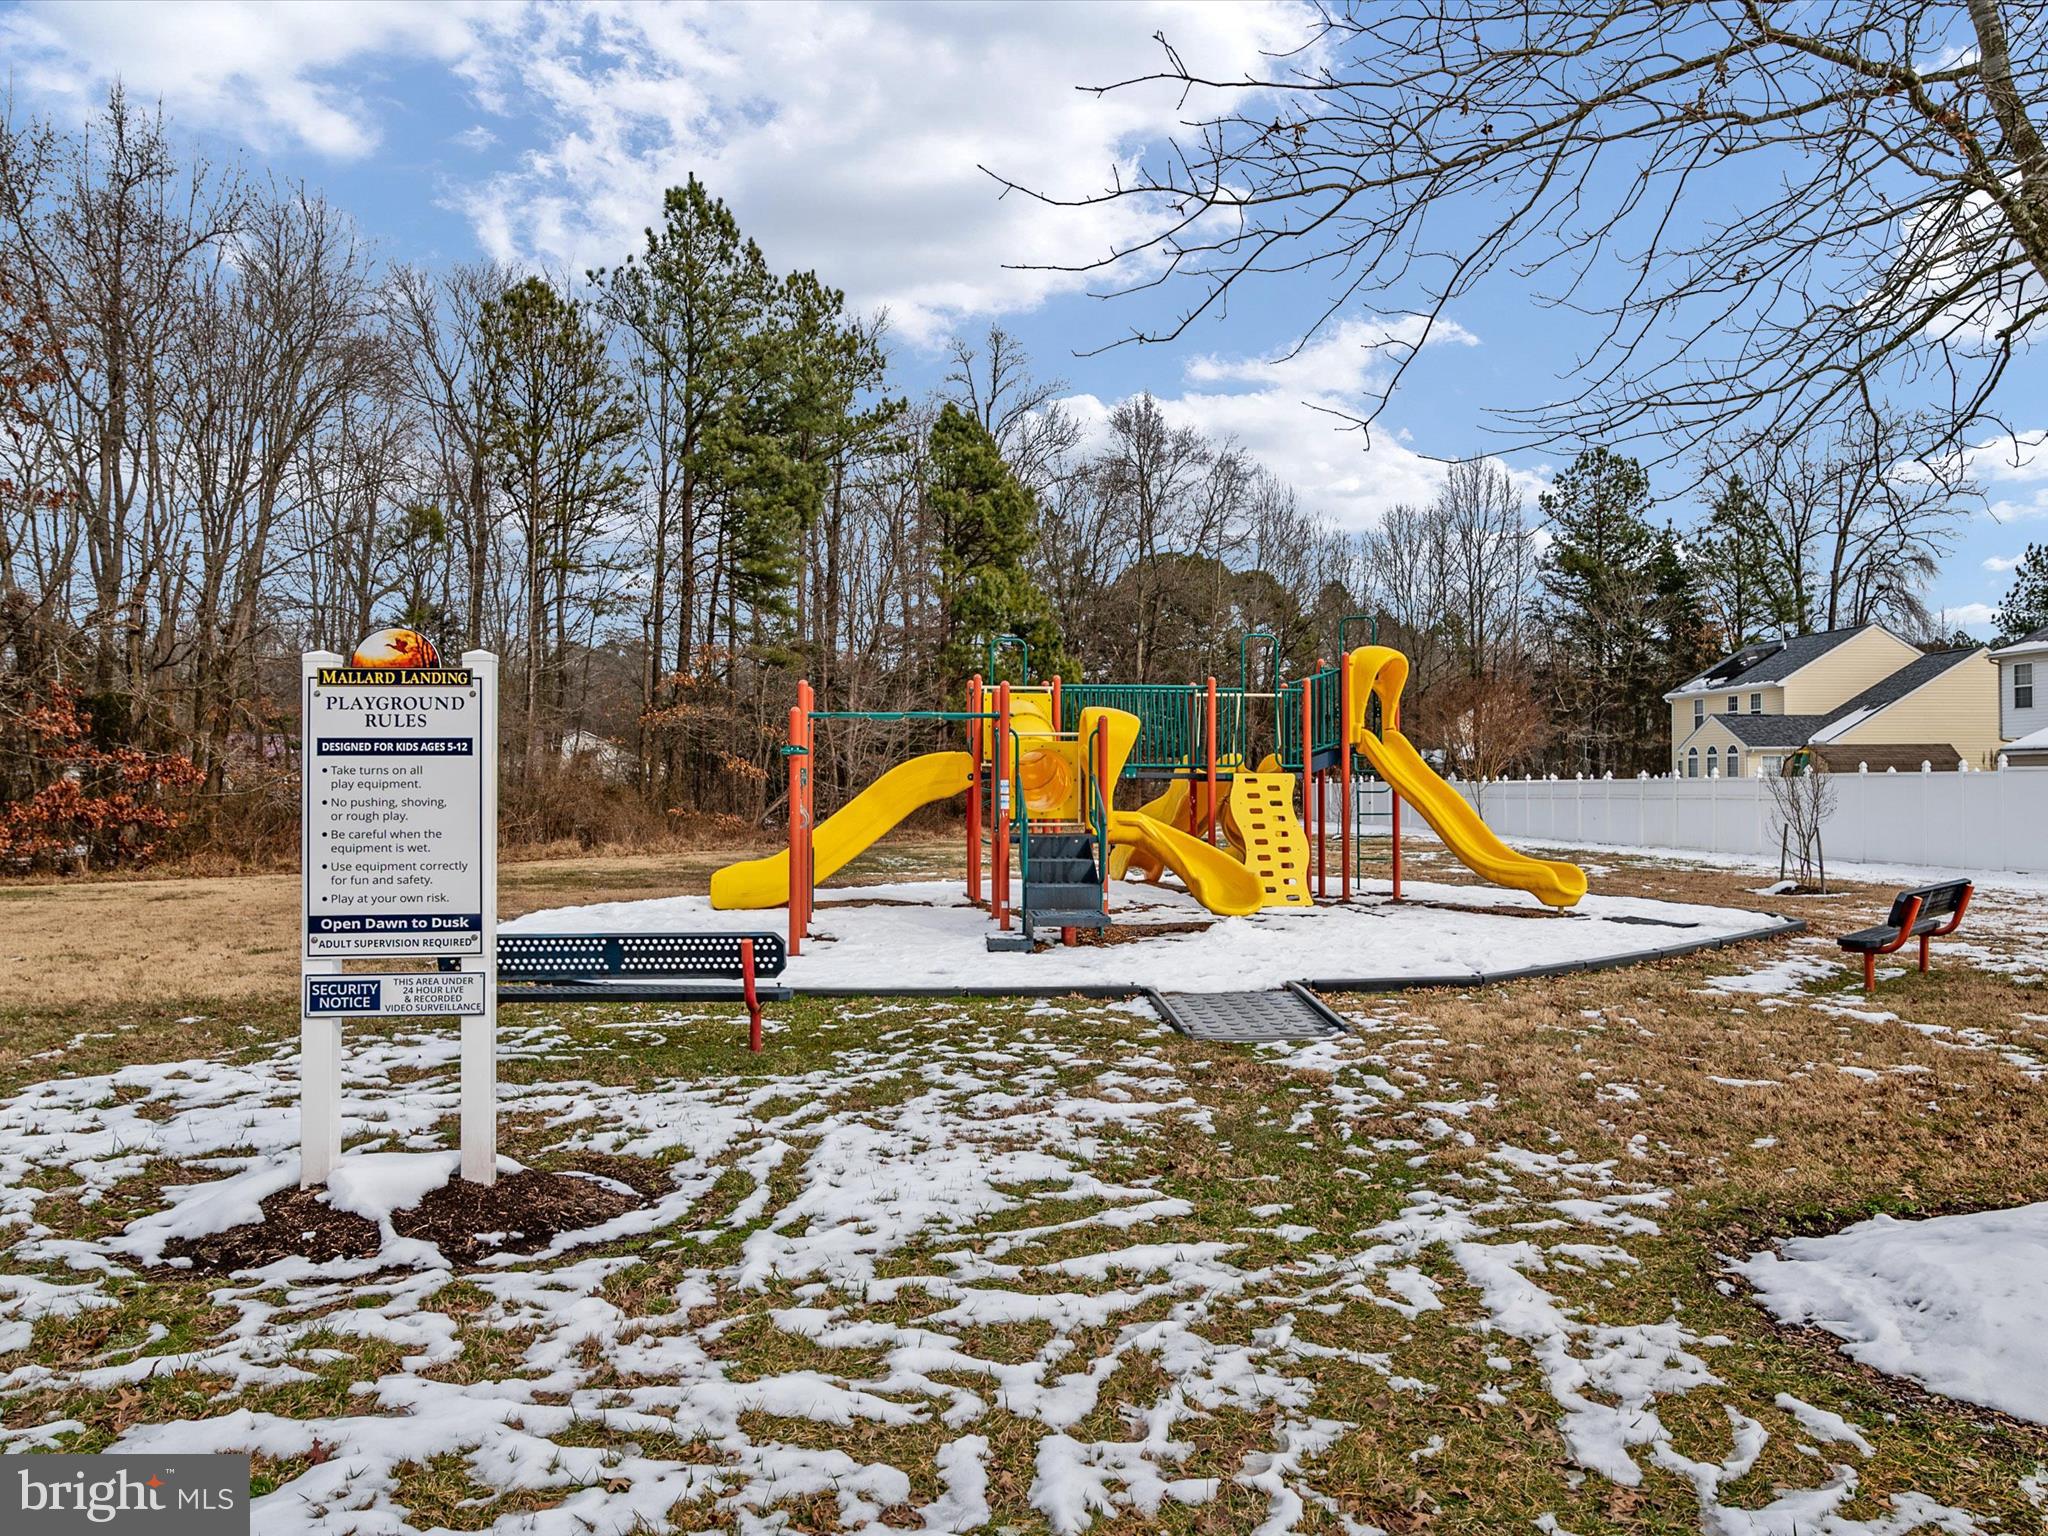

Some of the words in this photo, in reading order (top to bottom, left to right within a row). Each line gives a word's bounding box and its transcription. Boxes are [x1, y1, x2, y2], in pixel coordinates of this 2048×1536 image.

[323, 670, 395, 684] MALLARD
[401, 670, 468, 684] LANDING
[326, 697, 464, 710] PLAYGROUND
[365, 714, 427, 727] RULES
[322, 743, 370, 751] DESIGNED
[374, 743, 393, 751] FOR
[396, 743, 418, 751] KIDS
[420, 743, 445, 751] AGES
[448, 743, 467, 751] 5-12
[331, 766, 356, 775] Take
[359, 767, 389, 775] turns
[392, 767, 406, 775] on
[410, 765, 423, 775] all
[331, 779, 353, 791] play
[357, 779, 421, 791] equipment.
[331, 798, 347, 807] No
[351, 797, 397, 809] pushing,
[402, 797, 447, 808] shoving,
[331, 813, 343, 821] or
[347, 812, 379, 823] rough
[383, 812, 408, 823] play.
[331, 830, 345, 839] Be
[348, 830, 386, 839] careful
[390, 830, 421, 838] when
[424, 829, 442, 838] the
[331, 844, 392, 855] equipment
[396, 844, 404, 853] is
[408, 845, 430, 853] wet.
[331, 862, 352, 871] Use
[355, 862, 416, 873] equipment
[420, 861, 468, 872] correctly
[331, 876, 347, 885] for
[350, 876, 369, 885] fun
[372, 876, 393, 885] and
[397, 875, 432, 887] safety.
[331, 894, 353, 905] Play
[357, 895, 368, 903] at
[371, 895, 397, 905] your
[427, 893, 449, 902] risk.
[321, 919, 360, 932] Open
[365, 918, 407, 929] Dawn
[411, 919, 427, 928] to
[432, 917, 469, 928] Dusk
[319, 940, 351, 948] ADULT
[354, 939, 419, 947] SUPERVISION
[423, 937, 472, 947] REQUIRED
[441, 977, 473, 985] UNDER
[312, 984, 378, 995] SECURITY
[319, 997, 370, 1008] NOTICE
[385, 1004, 413, 1012] VIDEO
[415, 1003, 481, 1011] SURVEILLANCE
